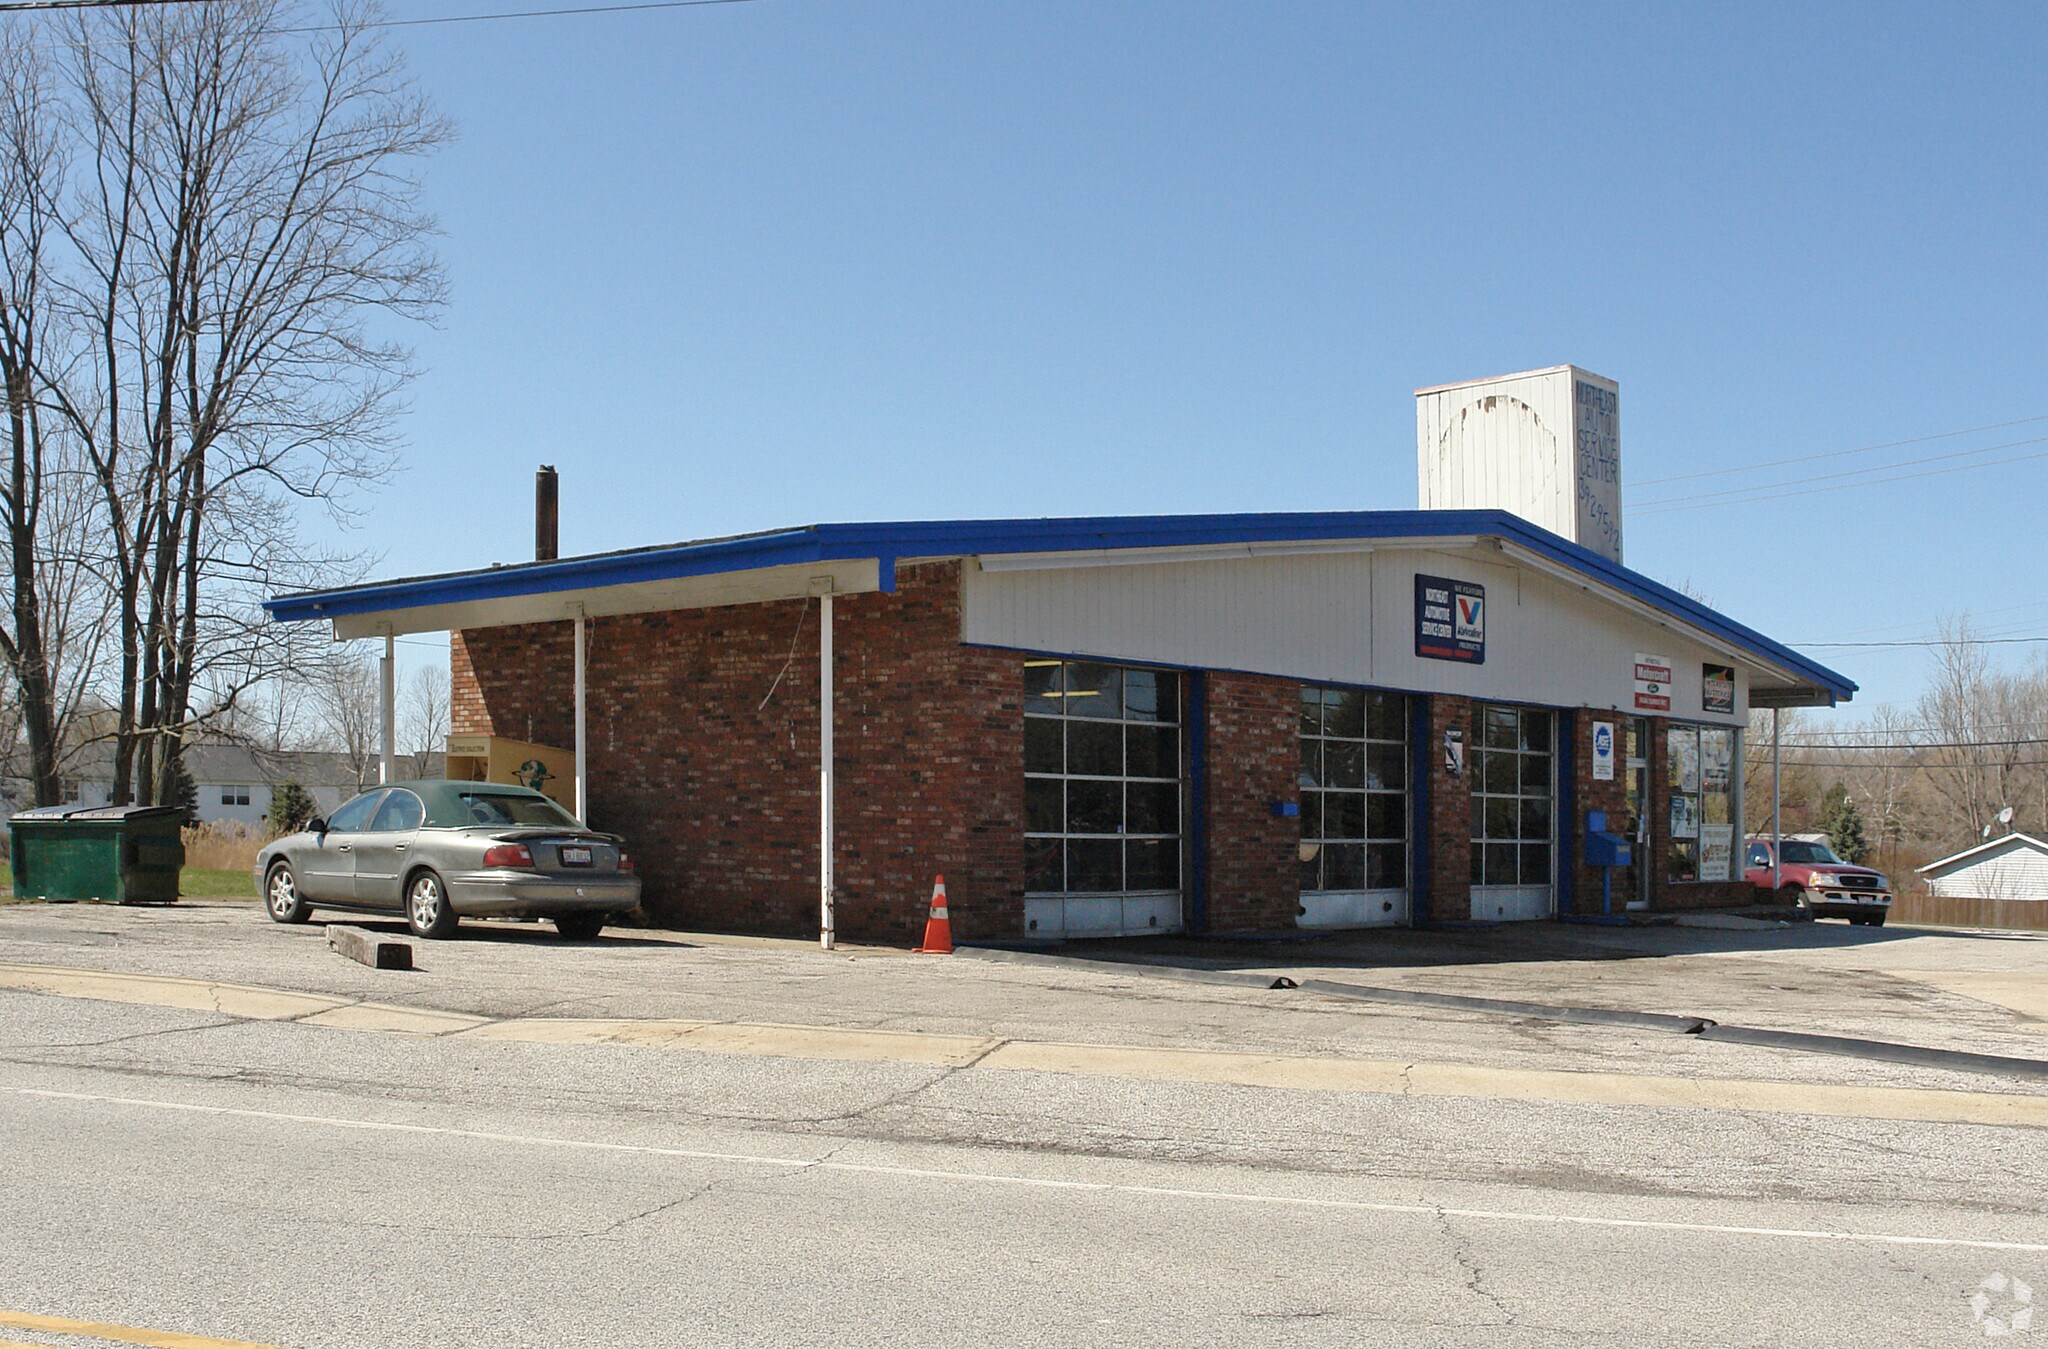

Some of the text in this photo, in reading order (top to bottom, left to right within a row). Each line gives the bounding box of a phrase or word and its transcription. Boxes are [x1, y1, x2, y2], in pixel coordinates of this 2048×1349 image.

[1576, 379, 1617, 414] NORTHEAST
[1585, 408, 1611, 435] AUTO
[1578, 428, 1617, 462] SERVICE
[1580, 453, 1617, 484] CENTER
[1457, 625, 1482, 639] Valvoline
[1637, 666, 1669, 683] Motorcraft
